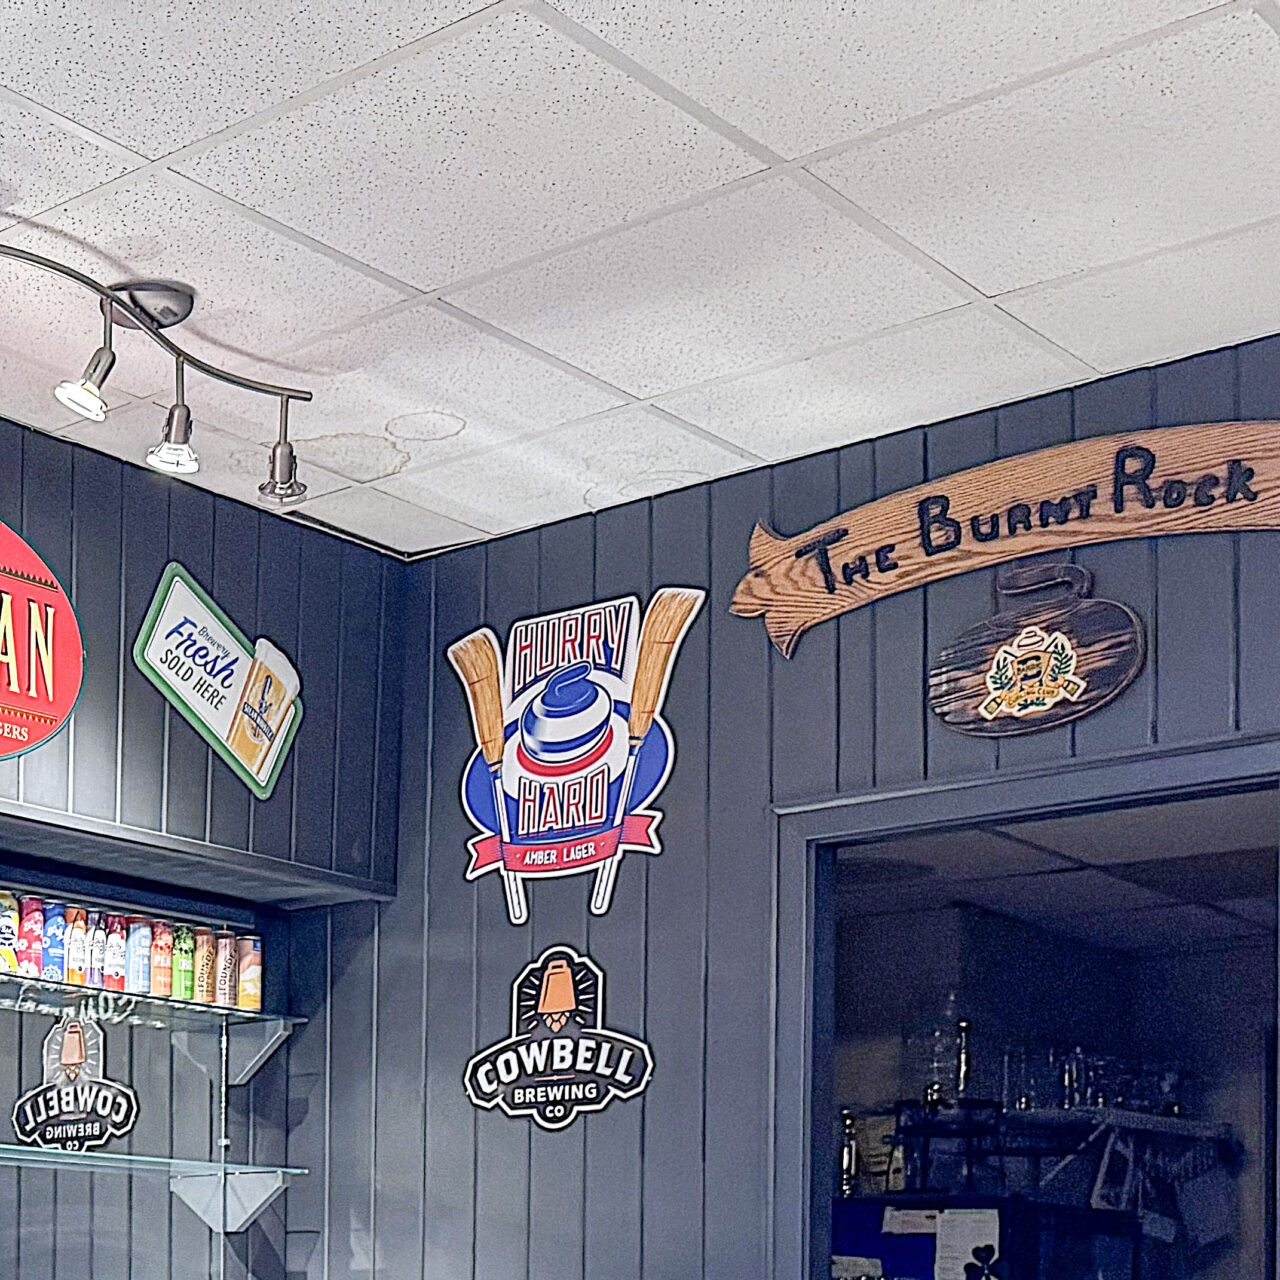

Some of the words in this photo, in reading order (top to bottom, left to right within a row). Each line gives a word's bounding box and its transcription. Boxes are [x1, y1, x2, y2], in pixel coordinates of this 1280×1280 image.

[164, 616, 240, 689] Fresh
[198, 626, 231, 660] Brewery
[514, 601, 631, 694] HURRY
[159, 649, 194, 683] SOLD
[192, 675, 228, 711] HERE
[518, 765, 609, 836] HARD
[523, 851, 557, 866] AMBER
[563, 843, 596, 862] LAGER
[476, 1037, 636, 1094] COWBELL
[514, 1083, 597, 1104] BREWING
[545, 1105, 565, 1118] CO
